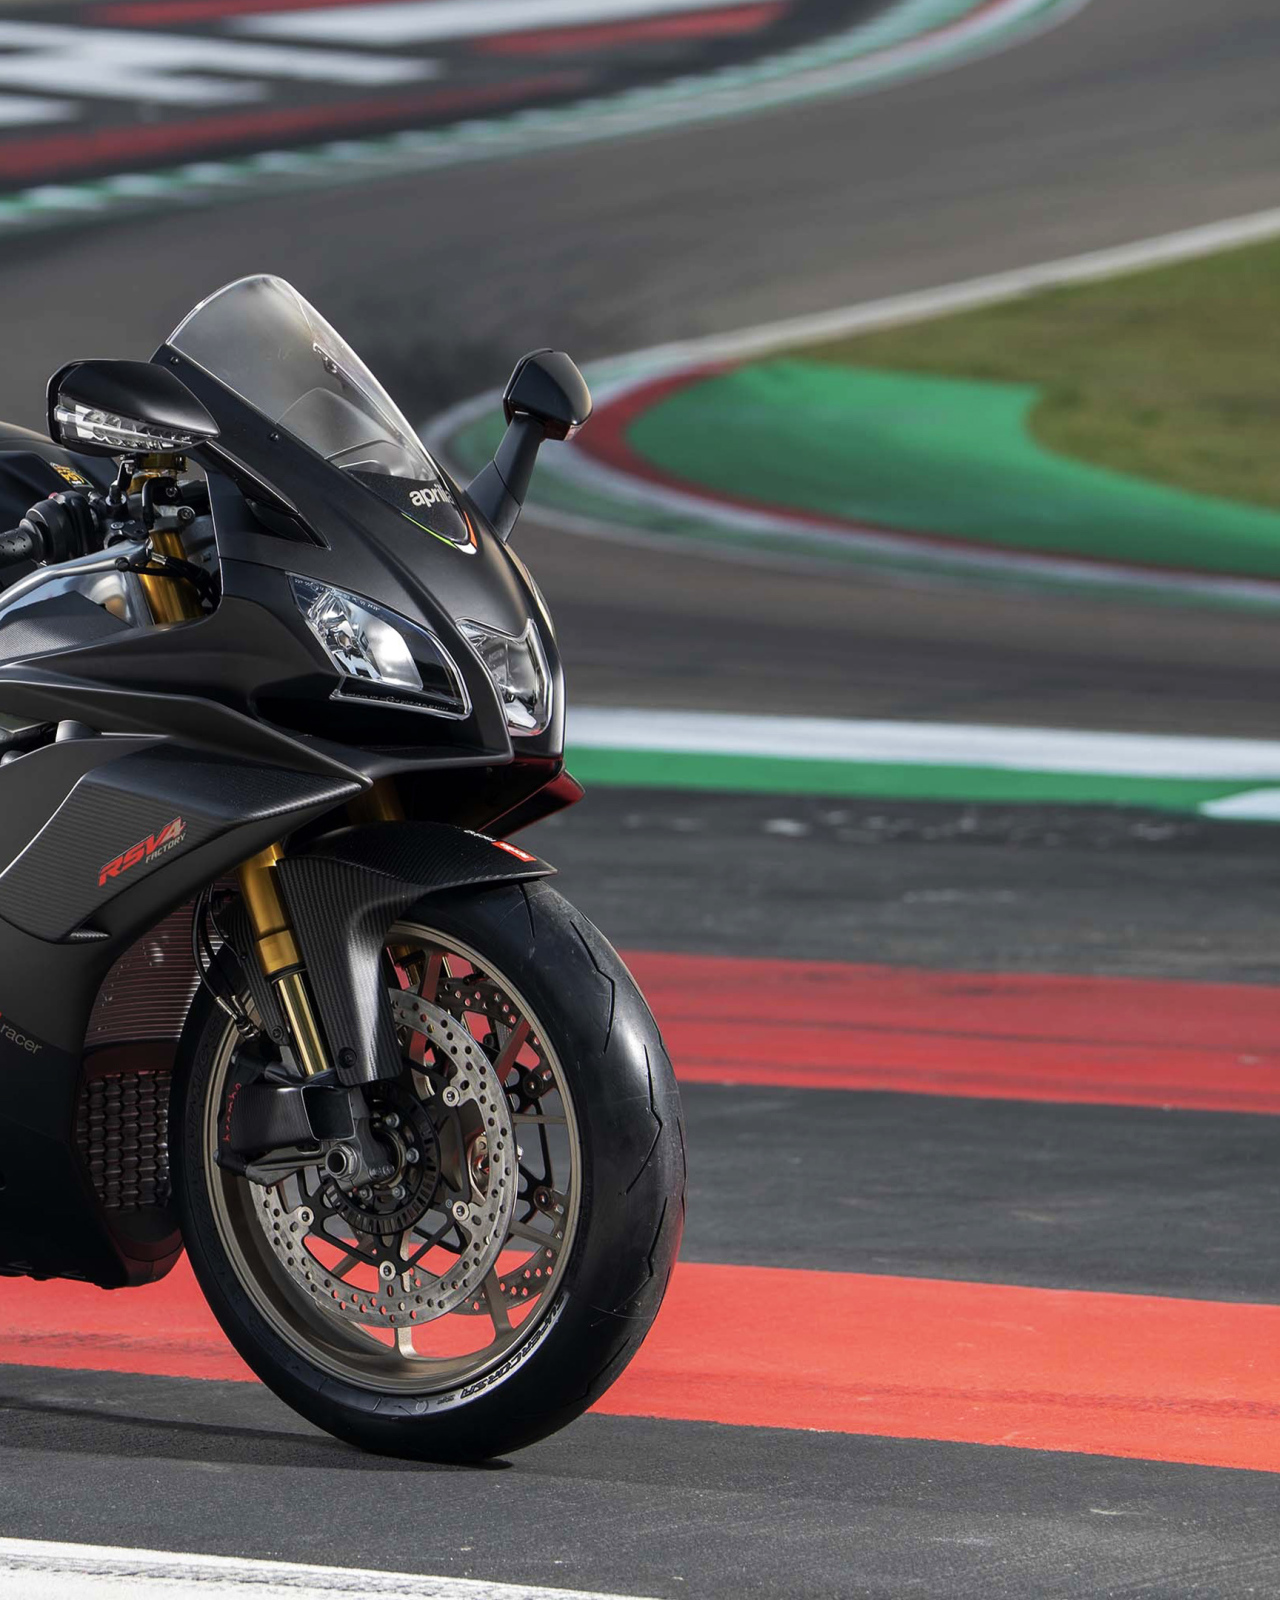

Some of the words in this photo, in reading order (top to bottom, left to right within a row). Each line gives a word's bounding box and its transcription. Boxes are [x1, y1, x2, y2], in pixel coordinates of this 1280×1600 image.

[97, 816, 185, 887] RSV4
[145, 832, 186, 863] FACTORY
[0, 1024, 42, 1054] racer
